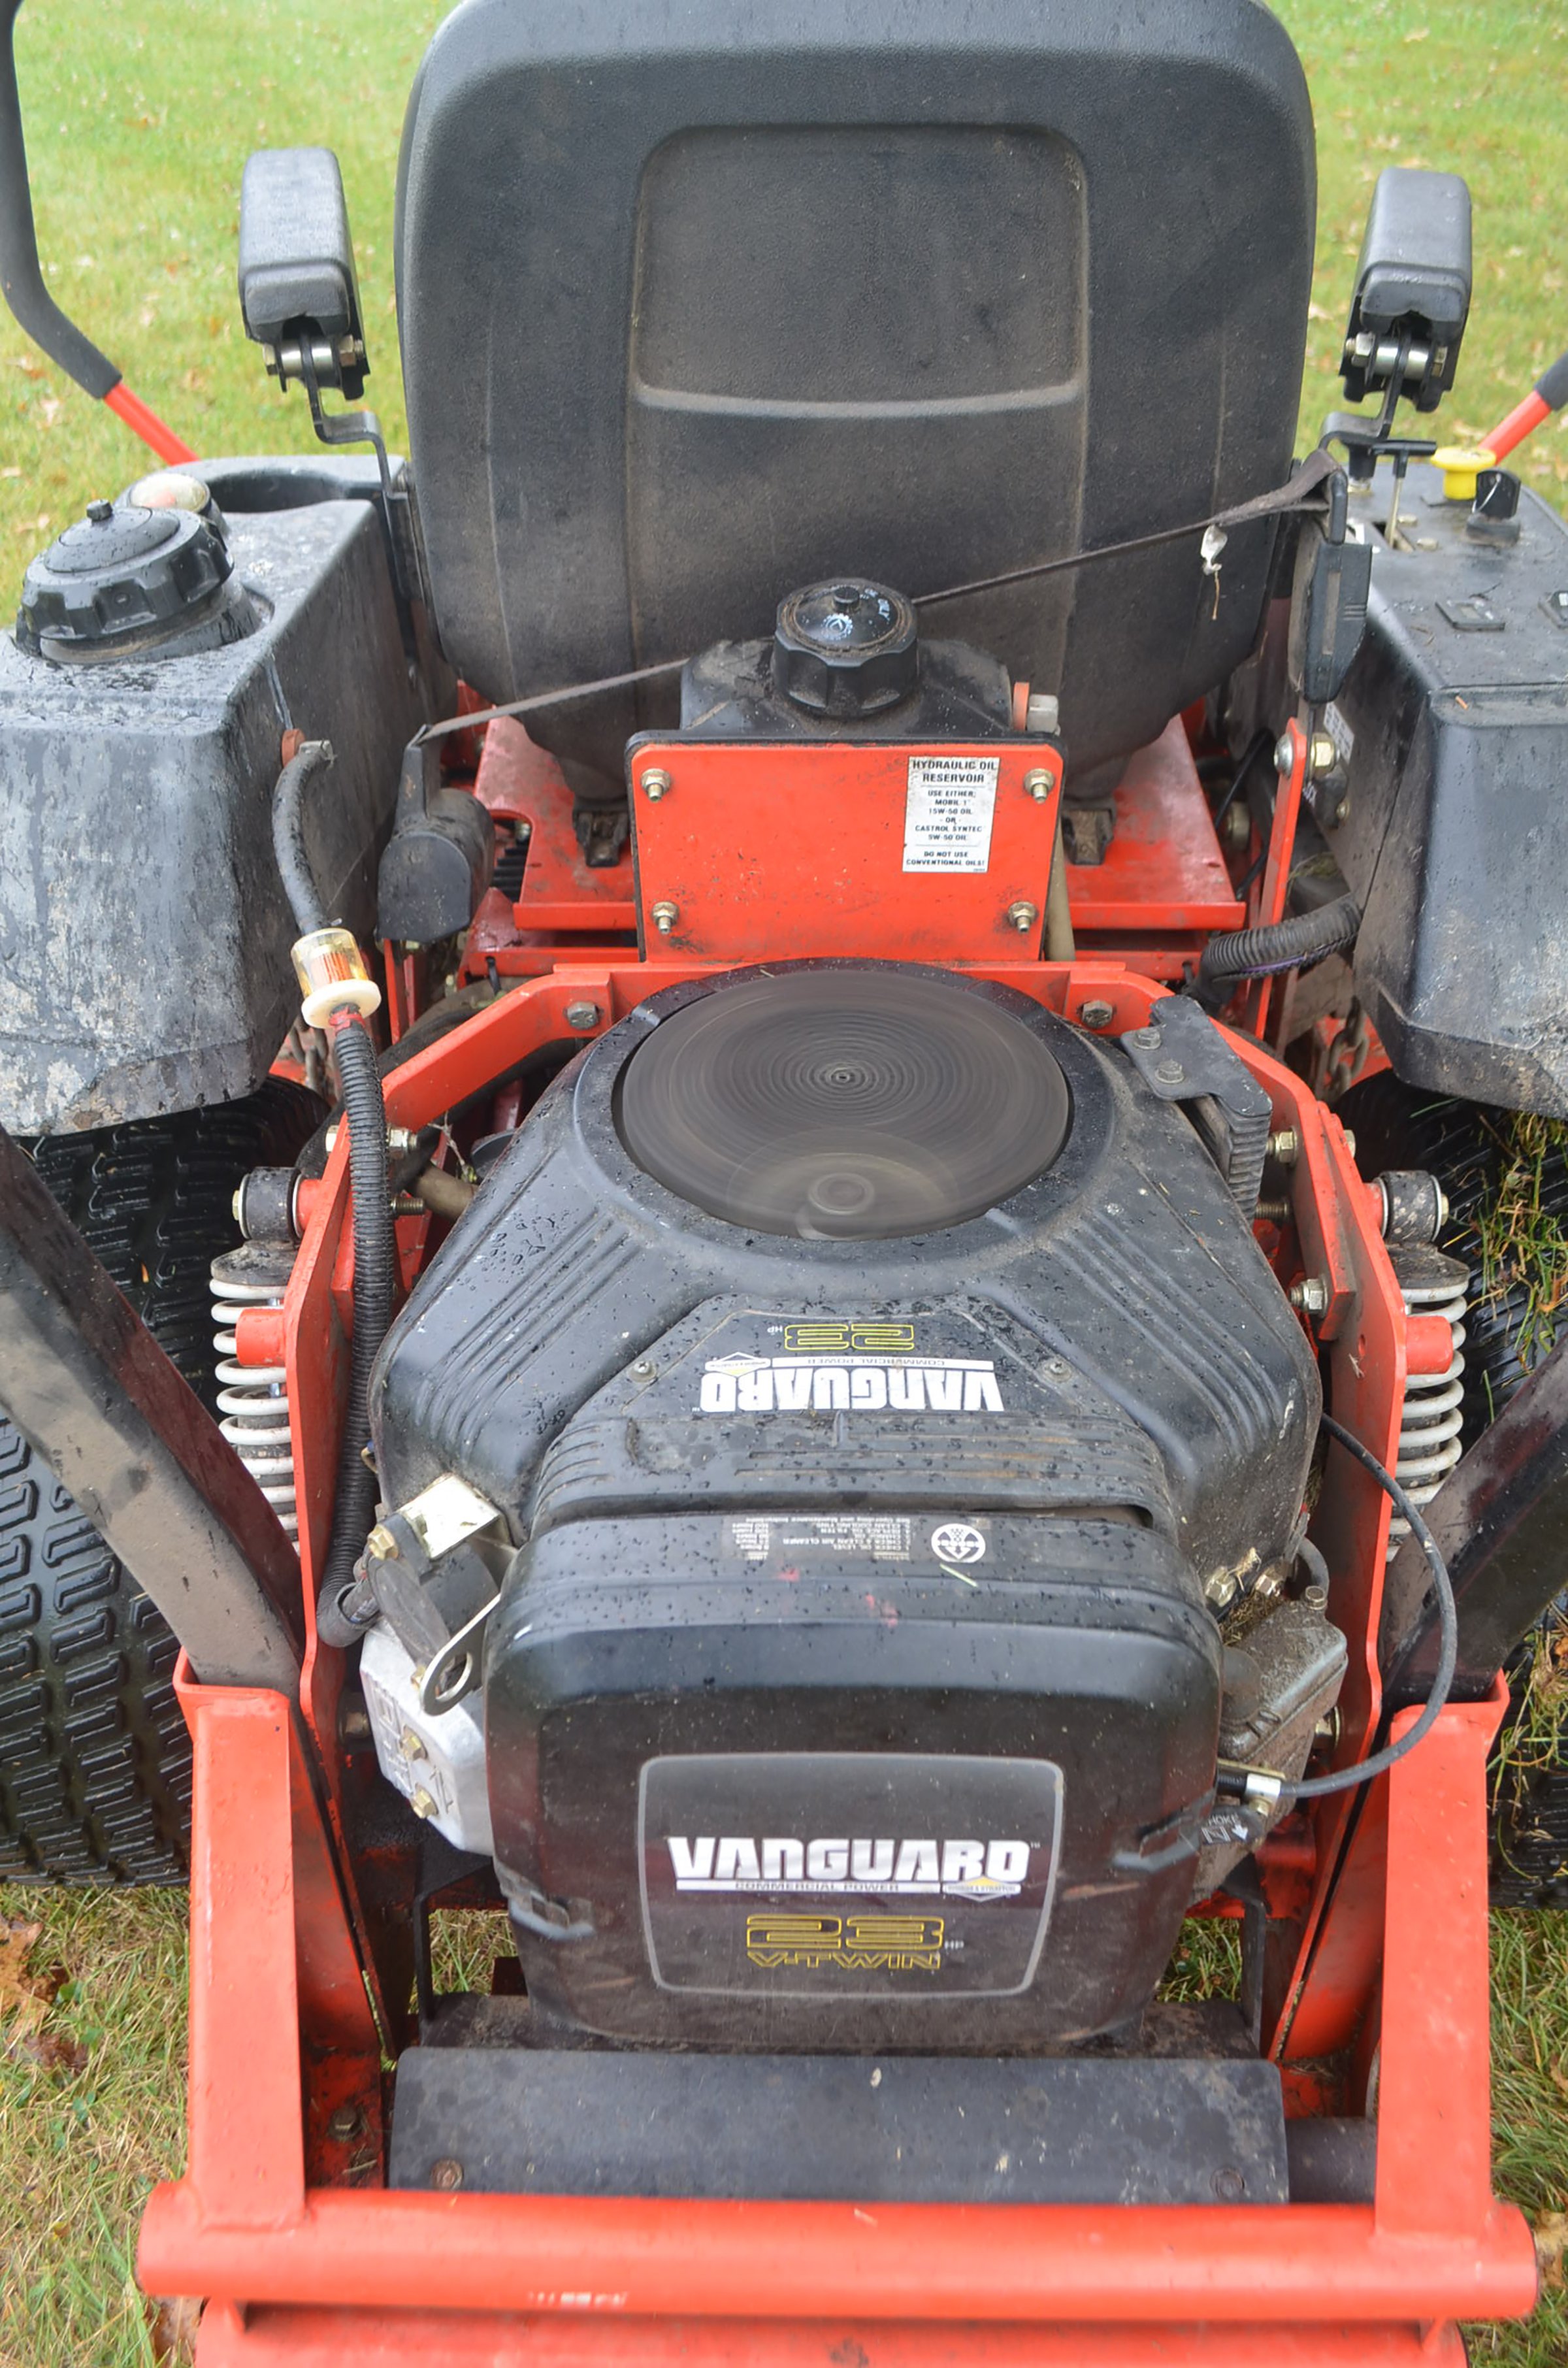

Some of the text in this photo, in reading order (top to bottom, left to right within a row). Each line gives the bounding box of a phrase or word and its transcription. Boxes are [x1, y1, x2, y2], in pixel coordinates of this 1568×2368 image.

[912, 759, 997, 770] HYDRAULIC OIL
[922, 773, 985, 783] RESERVOIR
[767, 1324, 914, 1351] 23 HP
[860, 1358, 945, 1366] COMMERCIAL
[700, 1368, 1005, 1413] VANGUARD
[1206, 1812, 1241, 1827] HOKE
[667, 1837, 1030, 1882] VANGUARD
[735, 1881, 900, 1892] COMMERCIAL POWER
[747, 1913, 944, 1950] 23
[747, 1950, 941, 1969] V-TWIN
